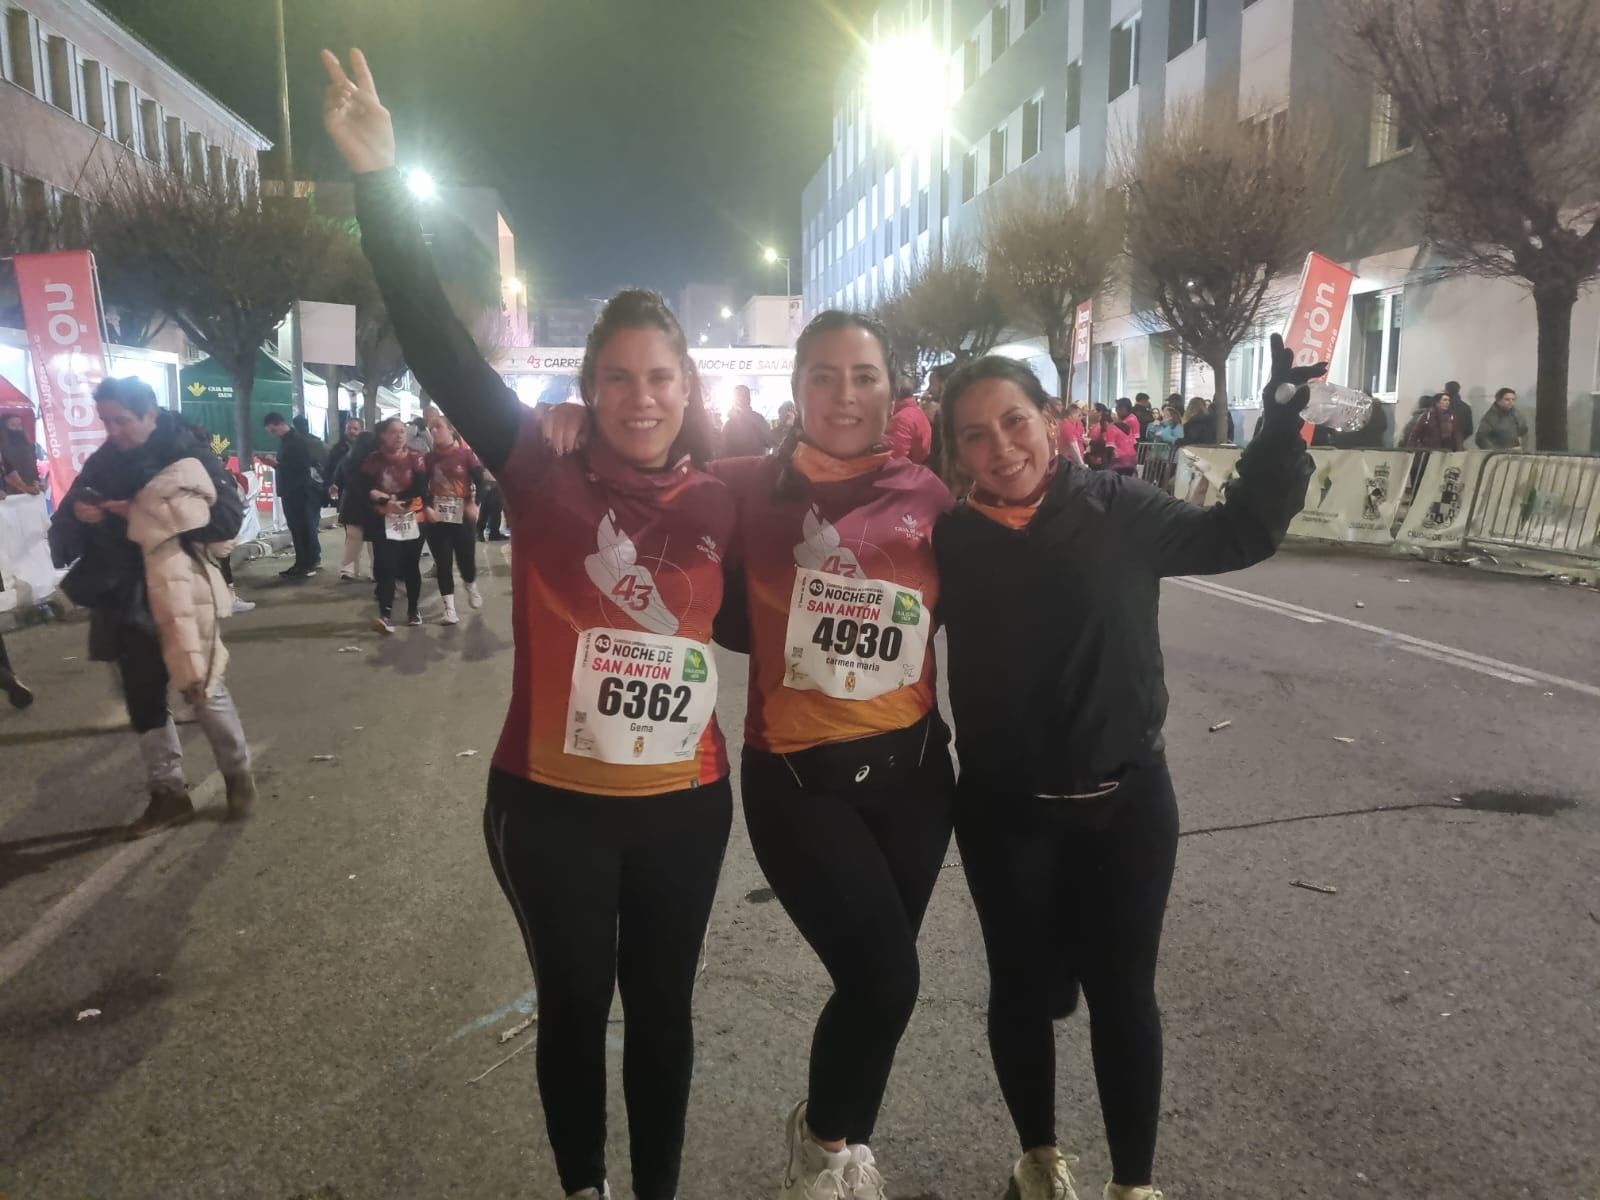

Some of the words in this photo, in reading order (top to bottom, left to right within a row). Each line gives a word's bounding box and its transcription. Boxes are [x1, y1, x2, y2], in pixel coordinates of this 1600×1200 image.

[526, 354, 541, 369] 43
[544, 358, 582, 368] CARRE
[698, 359, 736, 370] NOCHE
[738, 360, 753, 370] DE
[757, 360, 779, 370] SAN
[611, 574, 653, 611] 43
[825, 588, 866, 604] NOCHE
[866, 593, 883, 606] DE
[807, 599, 834, 614] SAN
[836, 604, 880, 621] ANTÓN
[595, 637, 611, 650] 43
[812, 617, 903, 662] 4930
[612, 644, 655, 662] NOCHE
[657, 650, 673, 664] DE
[826, 657, 855, 668] carmen
[592, 657, 623, 675] SAN
[624, 662, 671, 681] ANTÓN
[597, 677, 692, 723] 6362
[630, 722, 653, 733] Gema
